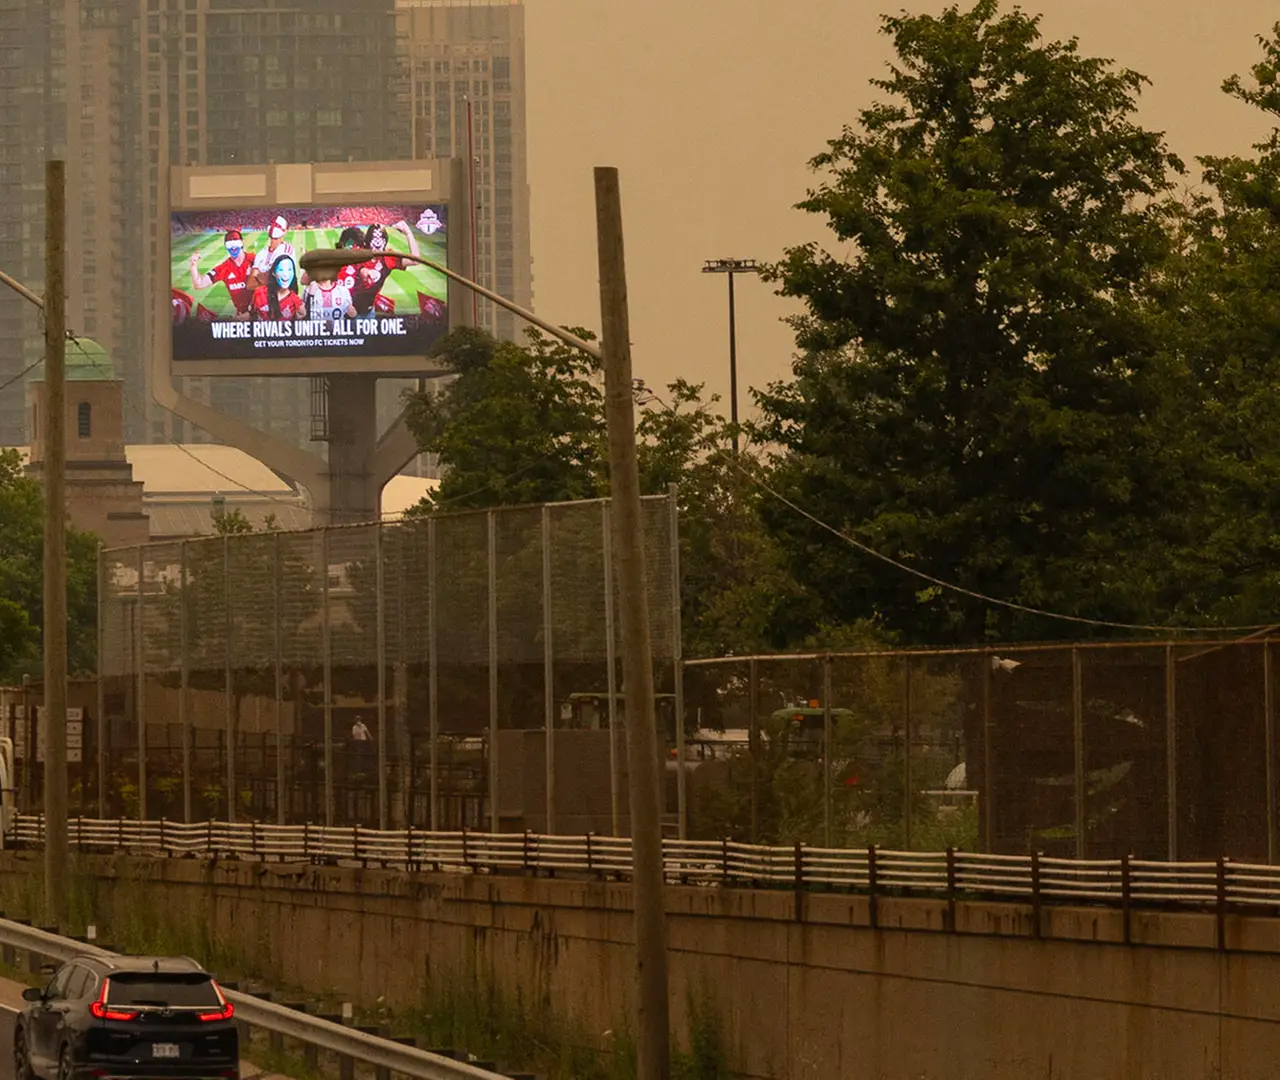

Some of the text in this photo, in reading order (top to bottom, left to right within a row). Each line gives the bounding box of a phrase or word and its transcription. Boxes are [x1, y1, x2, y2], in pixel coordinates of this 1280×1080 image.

[211, 318, 407, 339] WHERE RIVALS UNITE. ALL FOR ONE.
[254, 338, 365, 348] GET YOUR TORONTO FC TICKETS NOW
